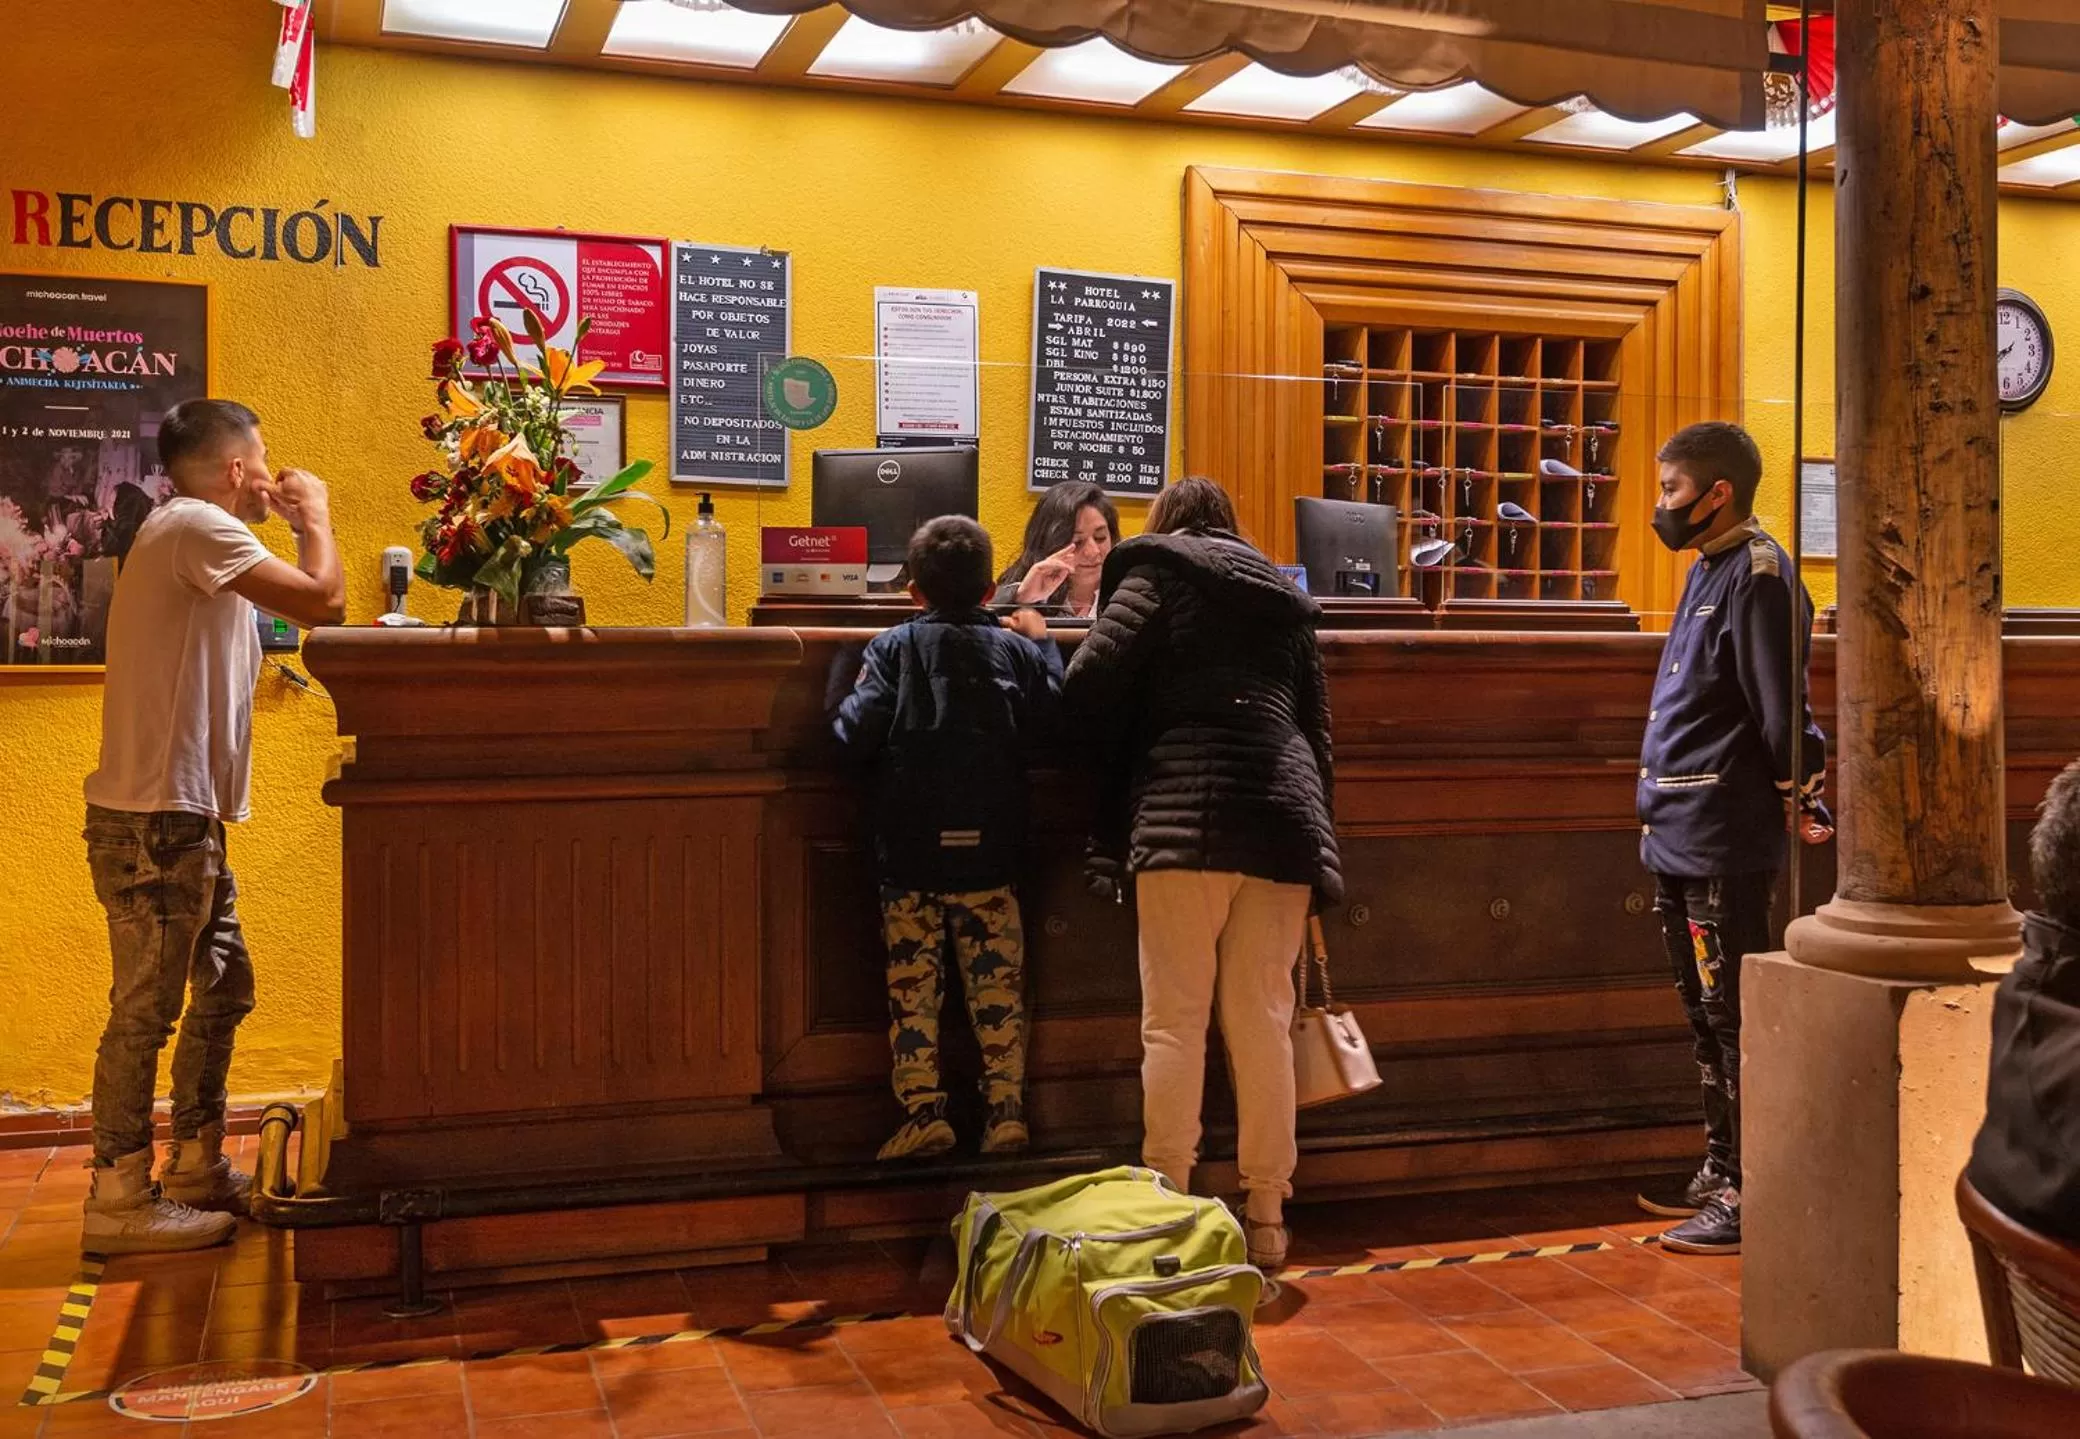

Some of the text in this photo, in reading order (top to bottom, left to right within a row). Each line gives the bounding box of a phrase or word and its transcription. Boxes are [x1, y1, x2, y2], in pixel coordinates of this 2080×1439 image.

[11, 189, 384, 268] RECEPCIÓN
[591, 259, 651, 269] ESTABLECIMIENTO
[680, 275, 774, 291] EL HOTEL NO SE
[1084, 286, 1120, 299] HOTEL
[679, 292, 787, 308] HACE RESPONSABLE
[1050, 295, 1136, 312] LA PARROQUIA
[691, 310, 770, 324] POR OBJETOS
[1053, 313, 1136, 329] TARIFA 2022
[1999, 311, 2011, 325] 12
[2015, 316, 2021, 329] 1
[51, 326, 66, 338] de
[67, 326, 144, 344] Muertos
[706, 328, 760, 340] DE VALOR
[1067, 326, 1106, 338] ABRIL
[2024, 328, 2031, 341] 2
[1045, 335, 1067, 346] SGL
[1072, 337, 1093, 348] MAT
[682, 343, 718, 354] JOYAS
[1045, 347, 1067, 357] SGL
[2028, 344, 2035, 357] 3
[683, 361, 748, 373] PASAPORTE
[1046, 359, 1067, 368] DBL
[2024, 361, 2032, 374] 4
[7, 377, 60, 388] ANIMECHA
[683, 378, 725, 389] DINERO
[1053, 371, 1099, 383] PERSONA
[1103, 375, 1136, 386] EXTRA
[2003, 377, 2011, 390] 6
[2017, 373, 2024, 386] 5
[1055, 382, 1092, 394] JUNIOR
[1095, 386, 1124, 397] SUITE
[1073, 395, 1147, 410] HABITACIONES
[1050, 405, 1153, 422] ESTAN SANITIZADAS
[684, 416, 783, 429] NO DEPOSITADOS
[1043, 416, 1164, 434] IMPUESTOS INCLUIDOS
[2, 426, 131, 440] 1 y 2 de NOVIEMBRE 2021
[1050, 429, 1144, 444] ESTACIONAMIENTO
[716, 435, 751, 445] EN LA
[1053, 441, 1073, 450] POR
[1079, 442, 1113, 454] NOCHE
[1035, 457, 1069, 468] CHECK
[1082, 459, 1094, 469] IN
[1140, 463, 1160, 474] HRS
[1034, 469, 1069, 479] CHECK
[1078, 471, 1098, 481] OUT
[1138, 475, 1159, 485] HRS
[788, 535, 831, 547] Getnet
[842, 573, 858, 581] VISA
